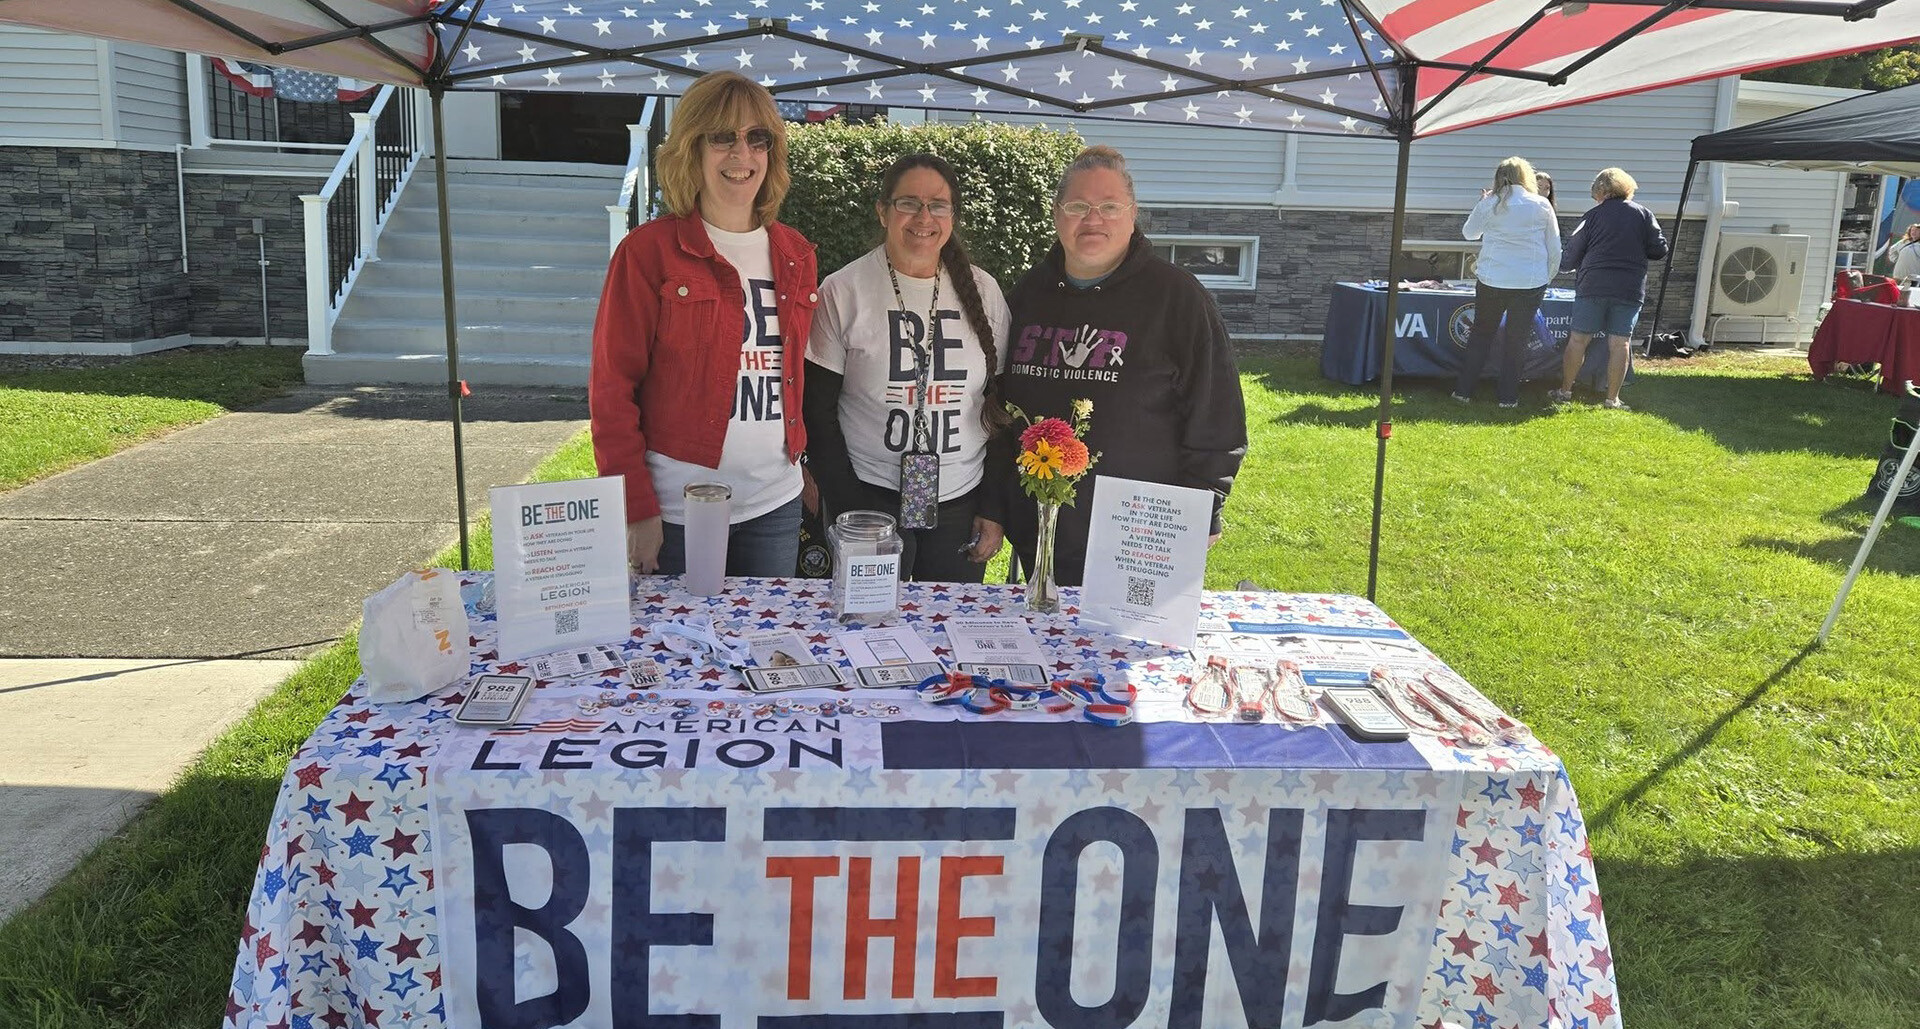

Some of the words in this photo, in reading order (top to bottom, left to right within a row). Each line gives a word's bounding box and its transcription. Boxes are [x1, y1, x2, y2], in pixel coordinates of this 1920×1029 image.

[1394, 313, 1429, 338] VA
[887, 309, 967, 381] BE
[1012, 324, 1128, 369] STP
[741, 351, 772, 370] HE
[1011, 364, 1060, 379] DOMESTIC
[1063, 369, 1120, 383] VIOLENCE
[729, 376, 782, 422] NE
[884, 408, 962, 454] ONE
[522, 504, 543, 526] BE
[544, 506, 565, 520] THE
[567, 498, 600, 521] ONE
[1140, 511, 1159, 519] YOUR
[1147, 506, 1182, 516] VETERANS
[1131, 517, 1148, 525] THEY
[1163, 522, 1188, 532] DOING
[1130, 527, 1153, 535] LISTEN
[1154, 530, 1176, 539] WHEN
[1136, 534, 1166, 545] VETERAN
[530, 550, 553, 558] LISTEN
[1121, 540, 1142, 548] NEEDS
[1154, 546, 1172, 554] TALK
[1132, 551, 1154, 560] REACH
[851, 564, 864, 576] BE
[876, 562, 895, 576] ONE
[1114, 555, 1136, 564] WHEN
[1144, 560, 1175, 571] VETERAN
[532, 566, 554, 575] REACH
[1126, 564, 1170, 578] STRUGGLING
[554, 581, 590, 590] AMERICAN
[540, 586, 590, 601] LEGION
[536, 662, 550, 671] BE
[634, 676, 661, 684] ONE
[767, 672, 782, 685] 988
[877, 670, 892, 681] 988
[600, 718, 842, 735] AMERICAN
[471, 737, 843, 770] LEGION
[464, 807, 727, 1029] BE
[766, 855, 1004, 1000] THE
[1035, 806, 1427, 1029] ONE
